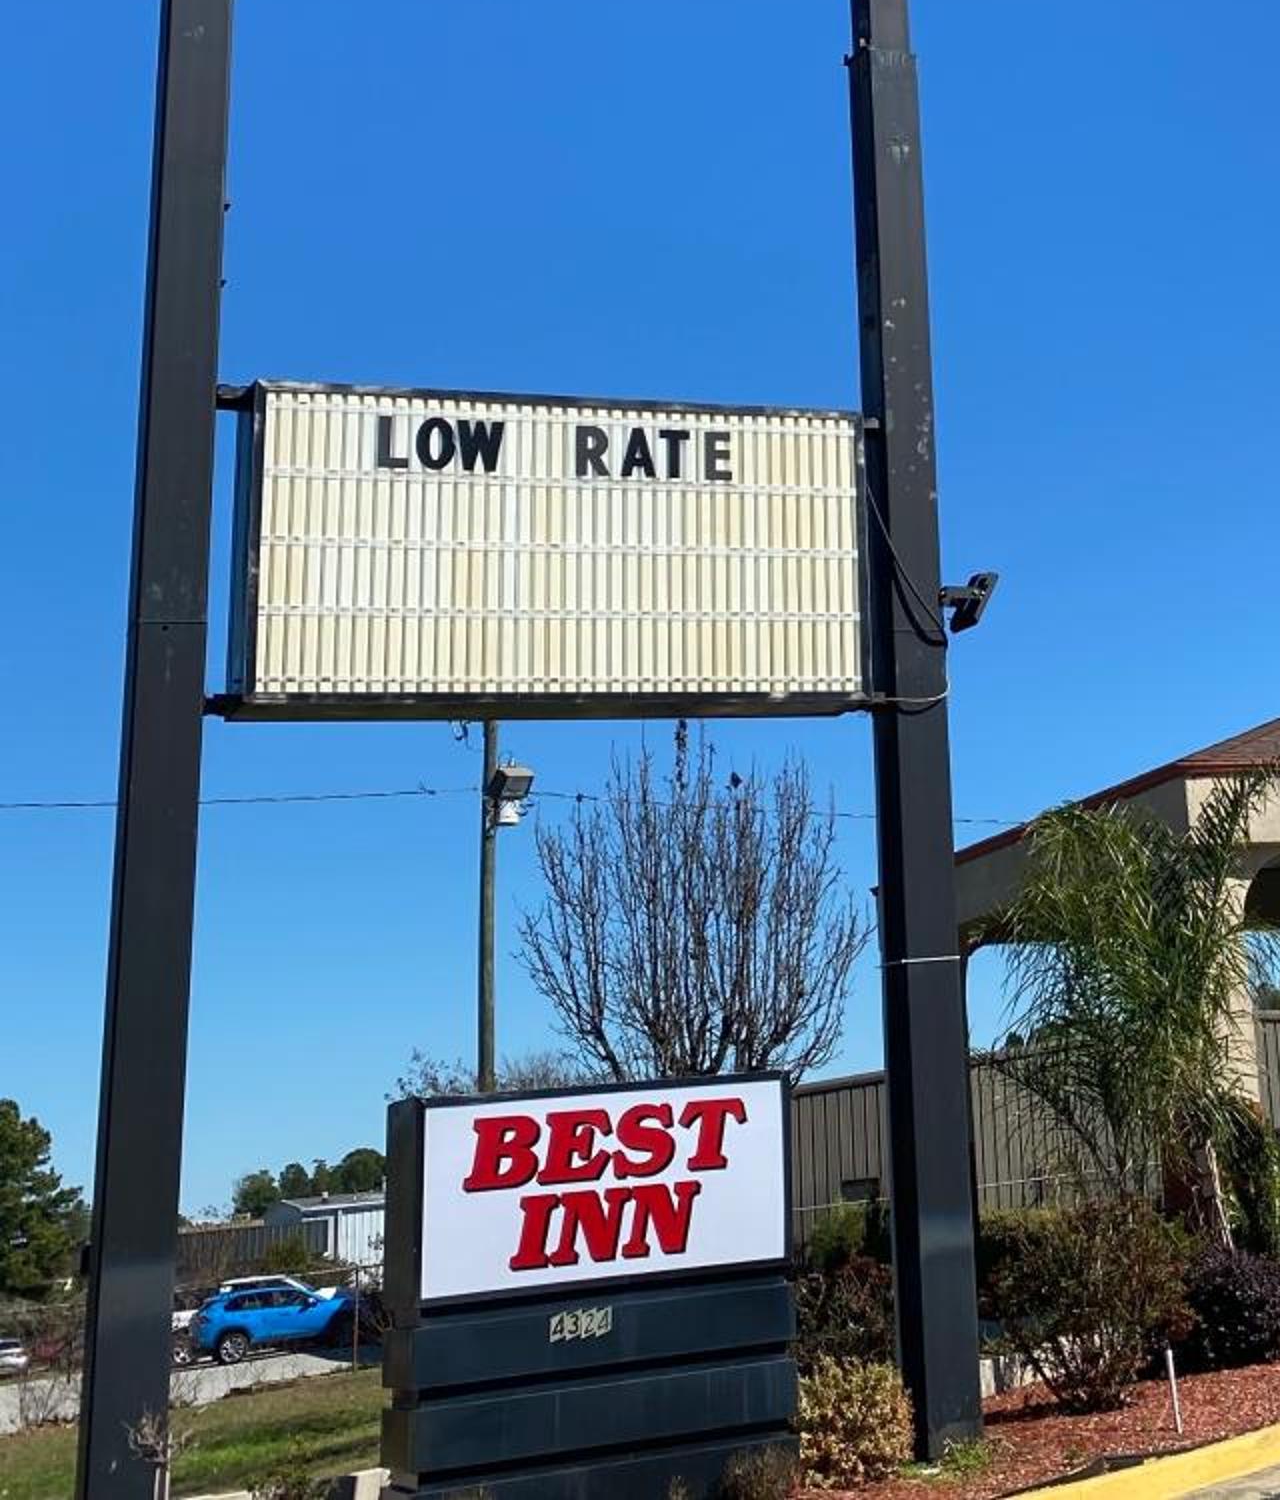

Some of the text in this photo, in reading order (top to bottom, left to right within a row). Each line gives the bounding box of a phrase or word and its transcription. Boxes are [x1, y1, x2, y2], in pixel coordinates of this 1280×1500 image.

[376, 414, 734, 482] LOW RATE
[463, 1097, 748, 1193] BEST
[509, 1180, 702, 1272] INN
[551, 1308, 610, 1337] 4324
